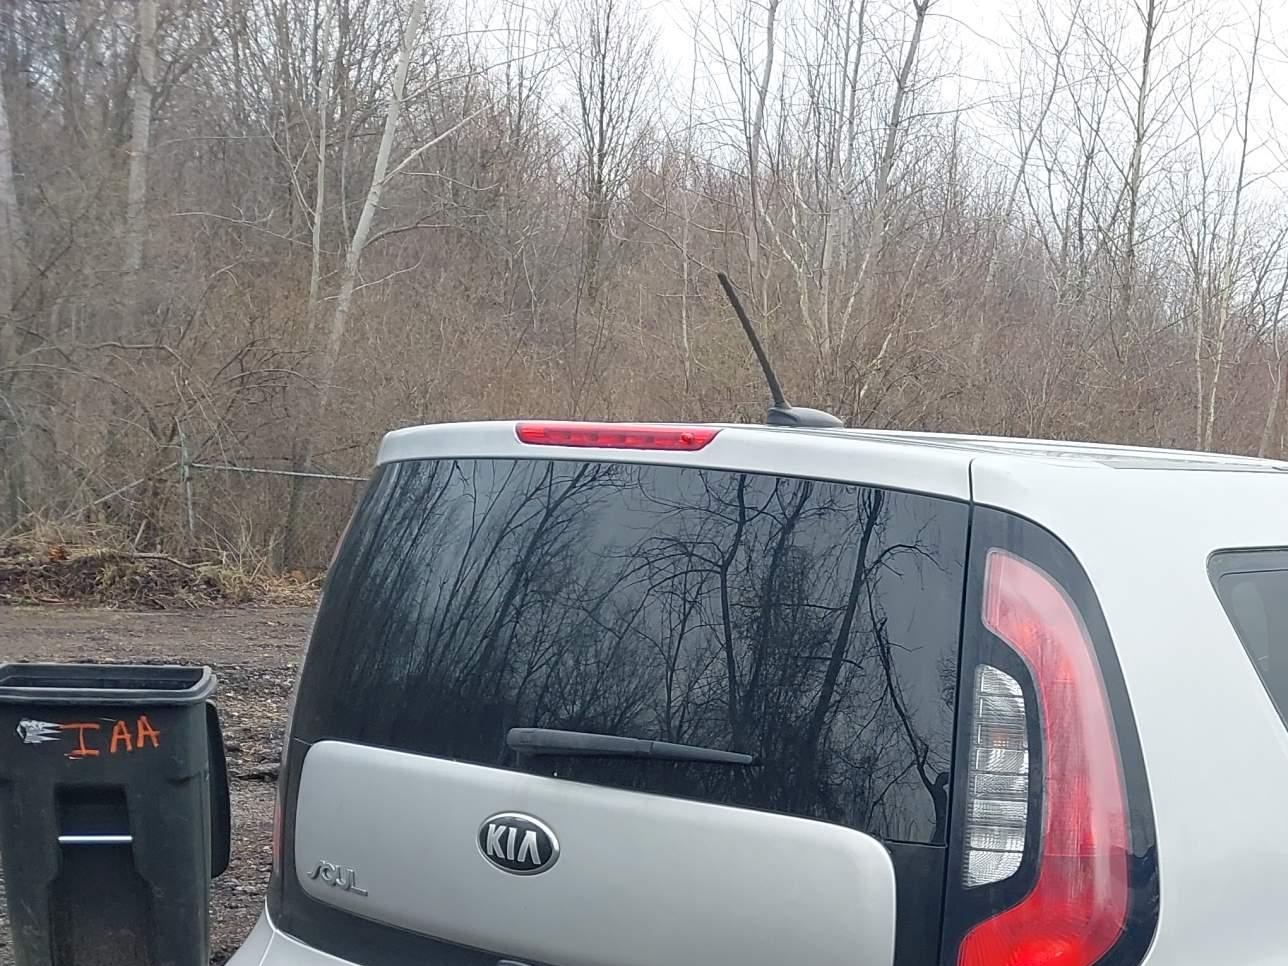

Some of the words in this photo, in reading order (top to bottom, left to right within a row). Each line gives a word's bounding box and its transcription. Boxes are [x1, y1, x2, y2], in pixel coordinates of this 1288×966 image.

[62, 715, 160, 756] IAA
[486, 823, 541, 865] KIA
[306, 859, 369, 897] SOUL
